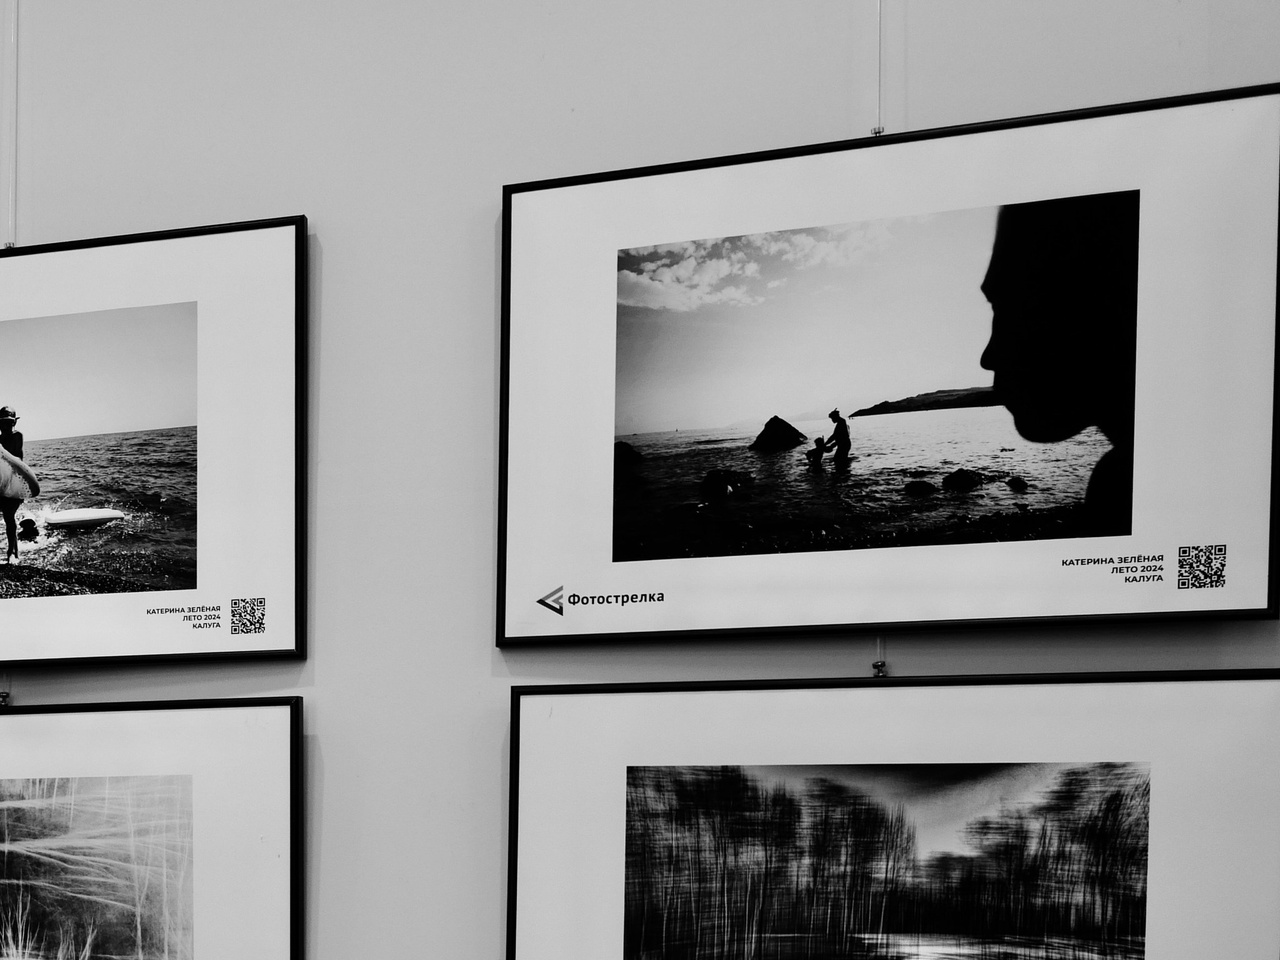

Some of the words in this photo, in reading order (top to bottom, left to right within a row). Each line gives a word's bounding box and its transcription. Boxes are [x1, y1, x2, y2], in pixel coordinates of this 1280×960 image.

[1061, 557, 1115, 566] КАТЕРИНА
[1117, 554, 1164, 563] ЗЕЛЁНАЯ
[1111, 566, 1138, 574] ЛЕТО
[1140, 565, 1164, 573] 2024
[1124, 574, 1164, 583] КАЛУГА
[567, 592, 665, 606] Фотострелка
[146, 607, 186, 615] КАТЕРИНА
[187, 605, 221, 613] ЗЕЛЁНАЯ
